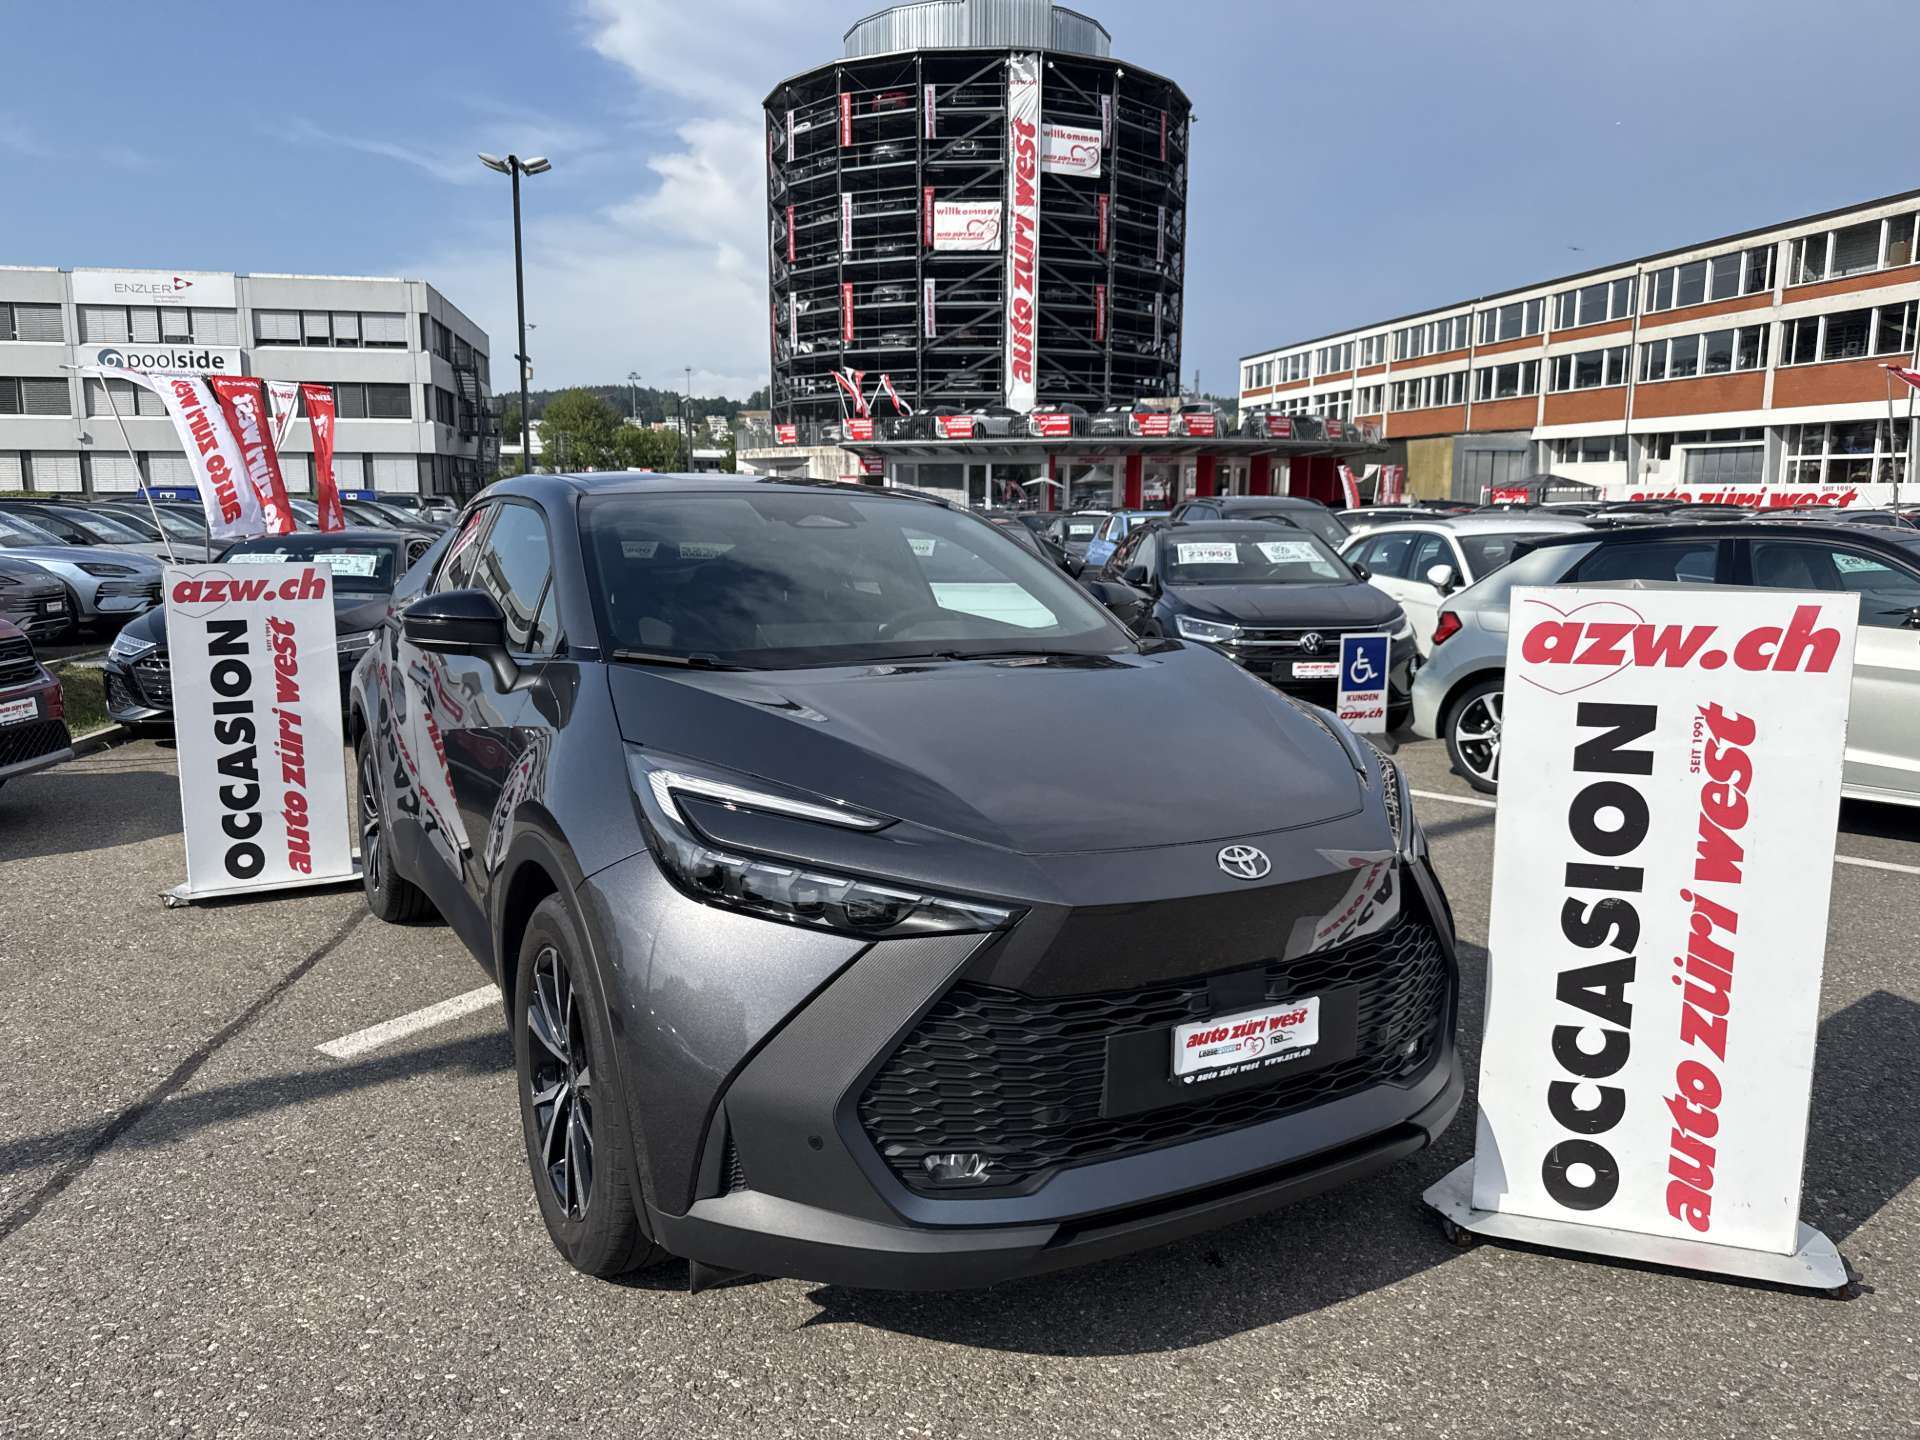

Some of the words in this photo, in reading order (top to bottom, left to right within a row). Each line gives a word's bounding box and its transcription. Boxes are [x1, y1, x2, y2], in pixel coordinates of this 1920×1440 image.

[1013, 117, 1036, 206] west
[1043, 128, 1100, 143] willkommen
[114, 283, 172, 294] ENZLER
[1010, 211, 1035, 296] züri
[127, 350, 225, 372] poolside
[1010, 298, 1033, 384] auto
[172, 568, 326, 604] azw.ch
[265, 616, 301, 703] west
[1521, 605, 1841, 674] azw.ch
[1340, 707, 1384, 720] azw.ch
[1346, 694, 1379, 702] KUNDEN
[1692, 716, 1705, 743] 1991
[206, 620, 265, 880] OCCASION
[272, 707, 307, 790] züri
[1690, 749, 1701, 774] SEIT
[1694, 701, 1757, 884] west
[281, 791, 312, 874] auto
[1541, 702, 1658, 1211] OCCASION
[1671, 888, 1739, 1064] züri
[1186, 1027, 1229, 1048] auto
[1230, 1016, 1268, 1039] züri
[1269, 1008, 1308, 1031] west
[1197, 1071, 1217, 1082] auto
[1220, 1066, 1239, 1077] züri
[1240, 1061, 1260, 1072] west
[1663, 1059, 1723, 1234] auto
